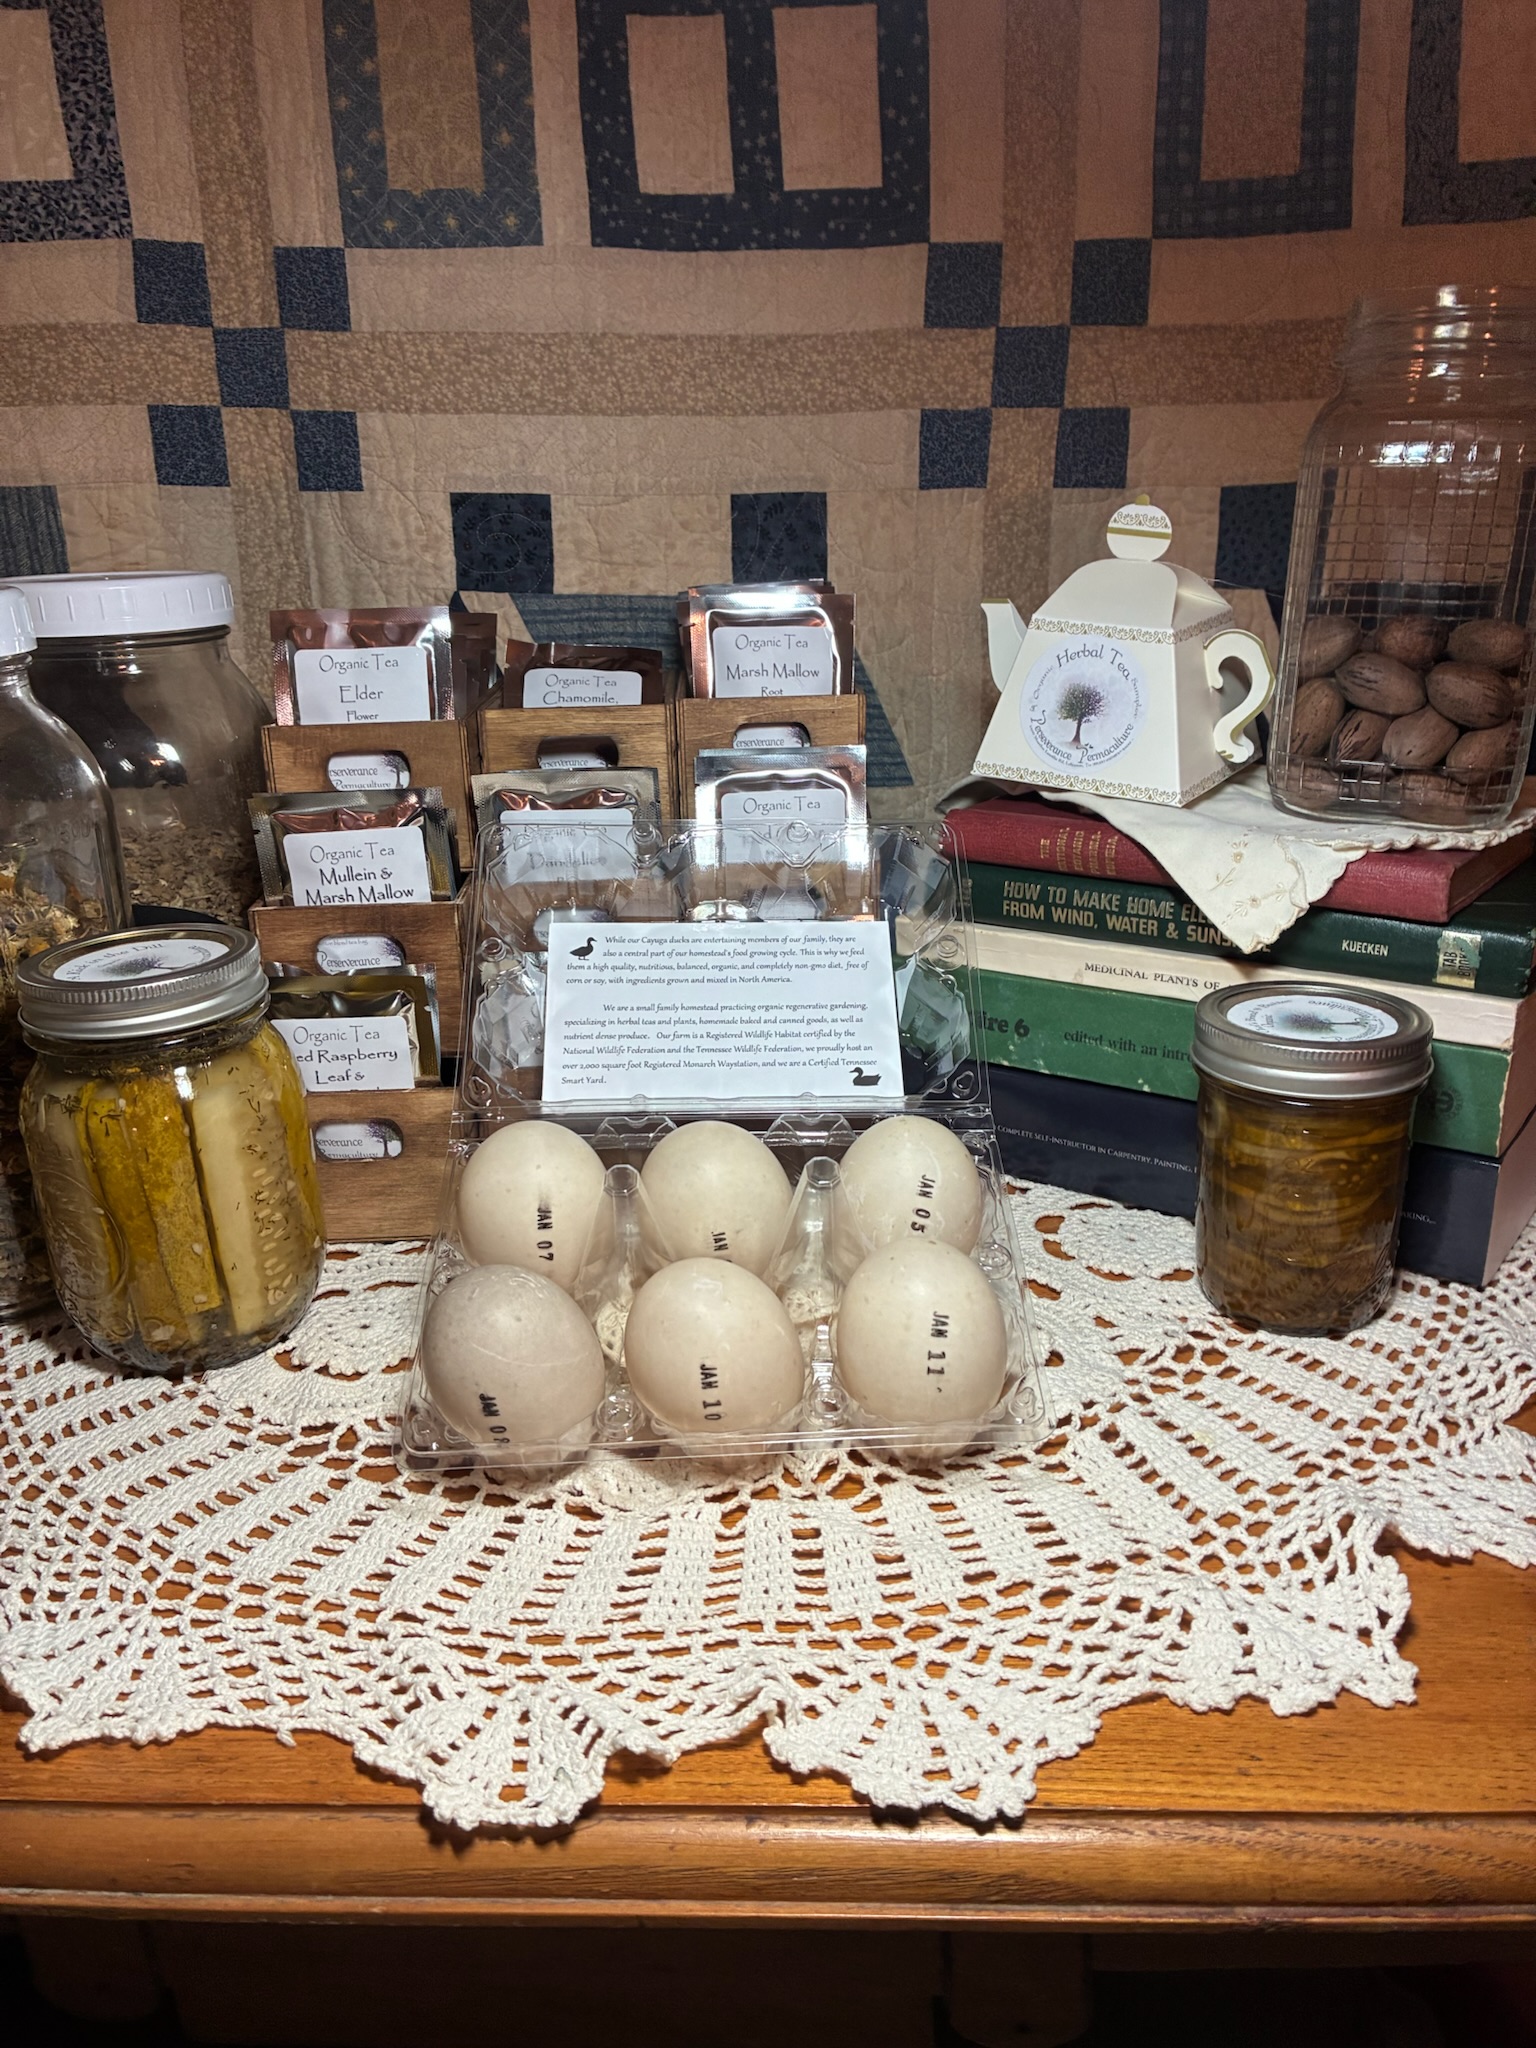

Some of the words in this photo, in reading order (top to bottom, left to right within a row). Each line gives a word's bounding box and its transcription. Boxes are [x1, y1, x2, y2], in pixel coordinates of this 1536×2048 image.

[735, 634, 782, 651] Organic
[784, 634, 808, 648] Tea
[320, 654, 370, 674] Organic
[372, 654, 399, 670] Tea
[727, 666, 768, 680] Marsh
[772, 663, 820, 680] Mallow
[1056, 644, 1104, 668] Herbal
[1110, 648, 1130, 681] Tea
[545, 674, 591, 690] Organic
[592, 675, 617, 688] Tea
[761, 686, 783, 697] Root
[340, 685, 384, 704] Elder
[542, 691, 619, 706] Chamomile,
[346, 710, 379, 721] Flower
[1076, 724, 1134, 764] Permaculture
[743, 798, 792, 816] Organic
[794, 796, 820, 812] Tea
[310, 845, 363, 865] Organic
[364, 842, 395, 860] Tea
[320, 866, 376, 886] Mullein
[380, 867, 393, 879] &
[306, 887, 355, 906] Marsh
[358, 884, 415, 904] Mallow
[1003, 880, 1041, 901] HOW
[1048, 886, 1068, 905] TO
[1073, 889, 1121, 912] MAKE
[1126, 896, 1175, 919] HOME
[1003, 900, 1044, 921] FROM
[1052, 906, 1098, 930] WIND,
[1106, 913, 1158, 937] WATER
[1166, 922, 1179, 940] &
[1186, 925, 1238, 947] SUNS
[640, 936, 667, 945] Cayuga
[703, 936, 746, 945] entertaining
[780, 935, 788, 944] of
[802, 934, 827, 944] family,
[828, 934, 843, 944] they
[1342, 940, 1389, 956] KUECKEN
[602, 948, 616, 956] also
[650, 950, 665, 958] part
[666, 948, 674, 958] of
[731, 948, 748, 958] food
[748, 949, 778, 958] growing
[823, 947, 838, 957] why
[848, 947, 864, 957] feed
[1443, 952, 1458, 968] TAB
[592, 962, 609, 972] high
[610, 961, 637, 972] quality,
[676, 962, 710, 970] balanced,
[710, 963, 739, 972] organic,
[756, 961, 793, 971] completely
[844, 960, 859, 970] free
[860, 960, 869, 970] of
[1084, 962, 1148, 980] MEDICINAL
[1154, 973, 1199, 988] PLANTS
[1204, 980, 1220, 990] OF
[625, 975, 665, 985] ingredients
[680, 1002, 718, 1010] homestead
[720, 1003, 756, 1012] practicing
[785, 1002, 828, 1012] regenerative
[564, 1017, 606, 1027] specializing
[1014, 1018, 1030, 1038] 6
[294, 1026, 346, 1046] Organic
[350, 1025, 380, 1042] Tea
[705, 1030, 742, 1041] Registered
[802, 1028, 832, 1039] certified
[1064, 1030, 1102, 1046] edited
[1109, 1038, 1136, 1053] with
[1141, 1044, 1158, 1056] an
[296, 1050, 314, 1062] ed
[318, 1050, 398, 1066] Raspberry
[626, 1045, 665, 1053] Federation
[733, 1044, 762, 1055] Wildlife
[763, 1044, 804, 1052] Federation,
[643, 1059, 681, 1070] Registered
[717, 1059, 760, 1069] Waystation,
[808, 1057, 839, 1068] Certified
[840, 1057, 877, 1070] Tennessee
[316, 1069, 351, 1085] Leaf
[354, 1071, 365, 1081] &
[998, 1125, 1034, 1140] COMPLETE
[1098, 1146, 1106, 1154] IN
[918, 1174, 936, 1199] JAN
[537, 1207, 553, 1230] JAN
[910, 1208, 931, 1233] 05
[537, 1240, 554, 1261] 07
[711, 1231, 728, 1252] JAN
[930, 1311, 950, 1338] JAN
[927, 1350, 946, 1375] 11
[700, 1364, 719, 1390] JAN
[479, 1393, 501, 1417] JAN
[702, 1400, 722, 1420] 10
